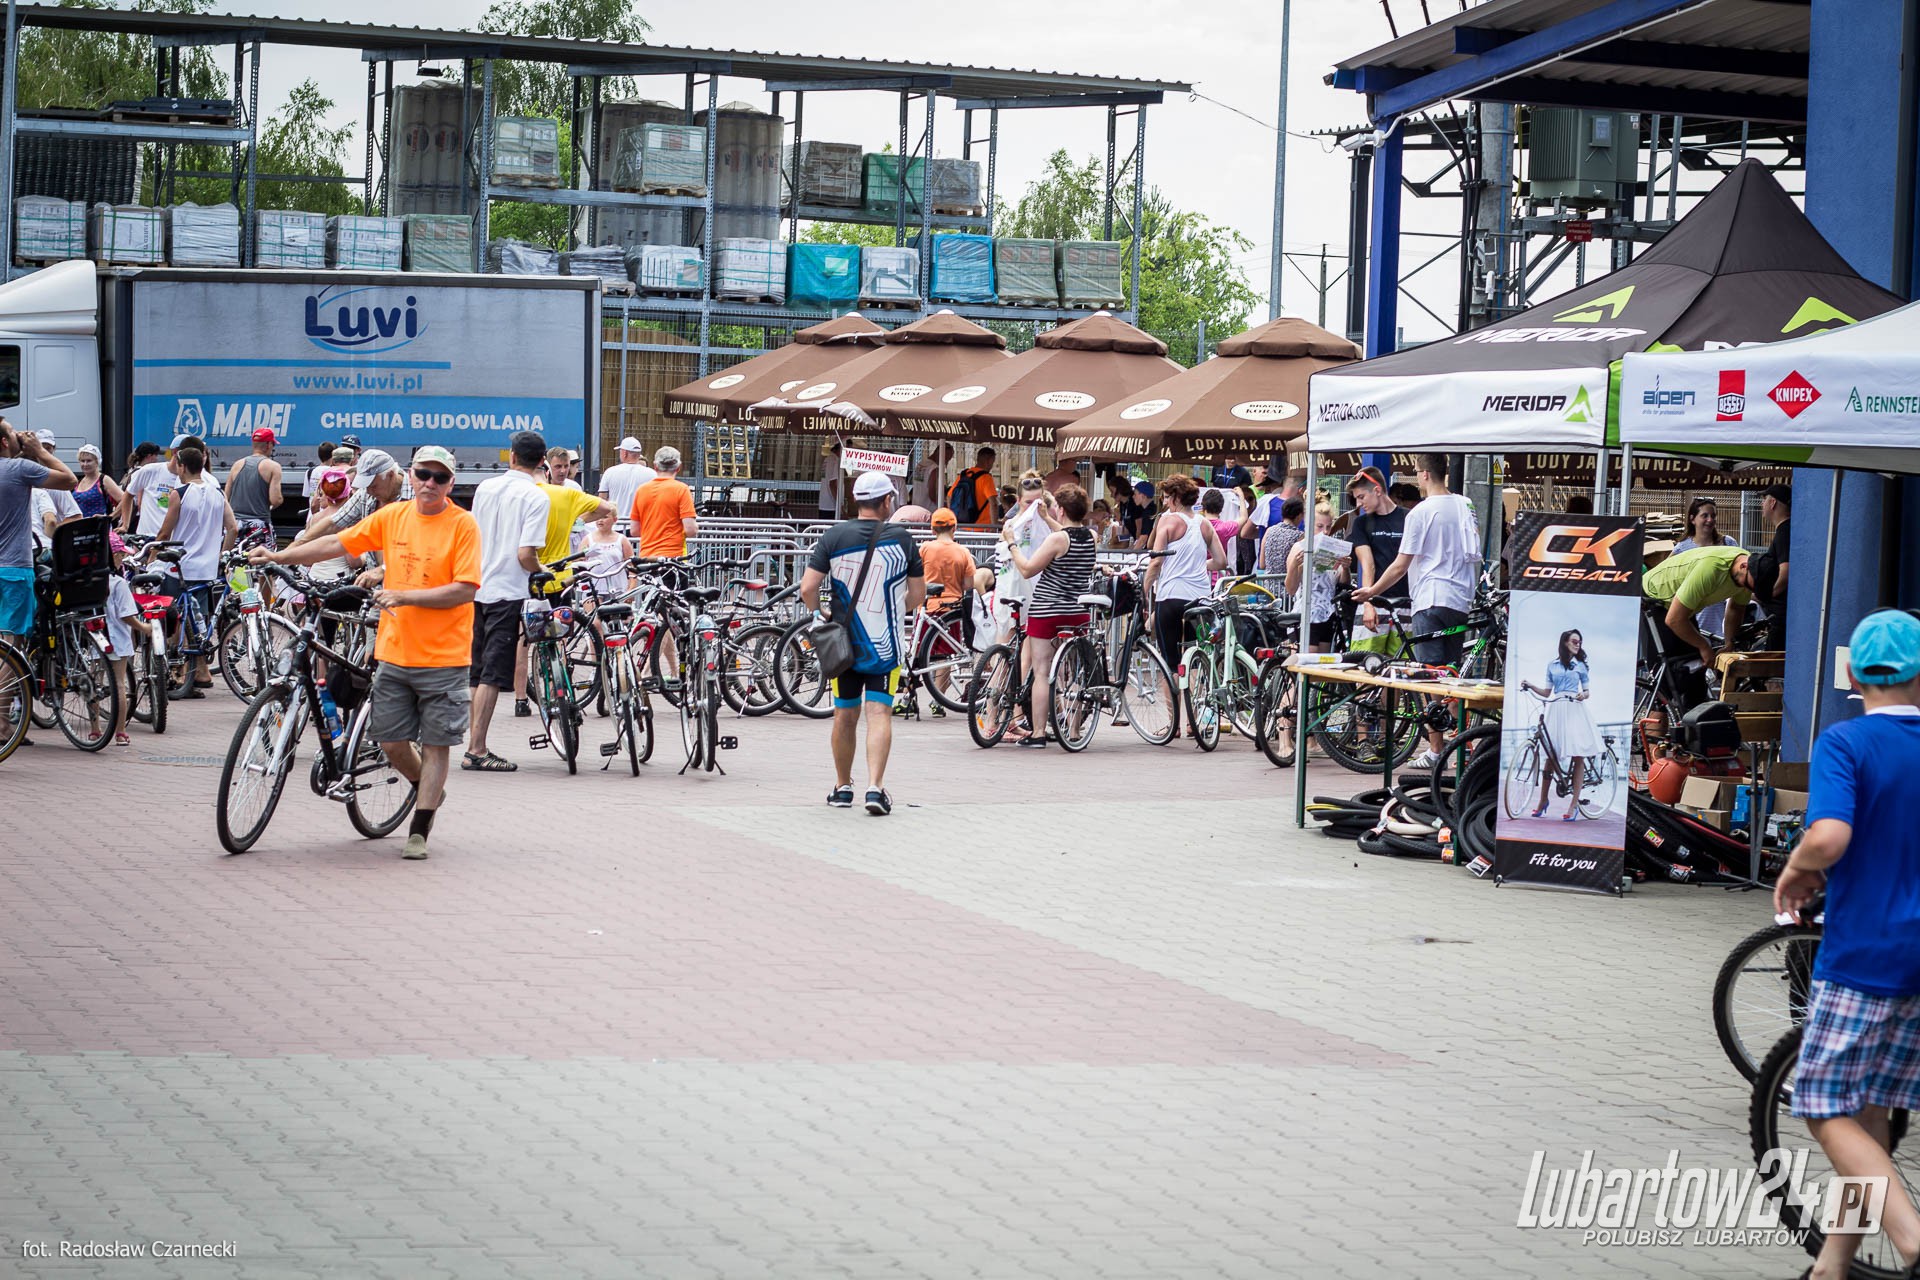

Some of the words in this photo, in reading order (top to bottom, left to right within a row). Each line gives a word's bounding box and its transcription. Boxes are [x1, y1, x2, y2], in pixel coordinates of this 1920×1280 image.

[305, 295, 417, 338] Luvi
[1453, 327, 1647, 345] MERIDA
[293, 372, 422, 394] www.luvi.pl
[1482, 395, 1567, 411] MERIDA
[1775, 387, 1813, 403] KNIPEX
[211, 403, 292, 437] MAPEI
[1317, 402, 1381, 422] MERIDA.com
[320, 412, 404, 430] CHEMIA
[410, 413, 544, 432] BUDOWLANA
[897, 417, 918, 431] LODY
[917, 419, 933, 432] JAK
[931, 420, 970, 435] DAWNIEJ
[991, 424, 1026, 440] LODY
[1028, 427, 1055, 443] JAK
[1062, 436, 1086, 453] LODY
[1083, 436, 1102, 452] JAK
[1102, 436, 1150, 455] DAWNIEJ
[1185, 438, 1226, 452] LODY
[1231, 439, 1260, 451] JAK
[845, 450, 906, 466] WYPISYWANIE
[1526, 454, 1571, 470] LODY
[1522, 566, 1633, 584] COSSACK
[1529, 852, 1550, 868] Fit
[1549, 853, 1572, 869] for
[1573, 858, 1597, 871] you
